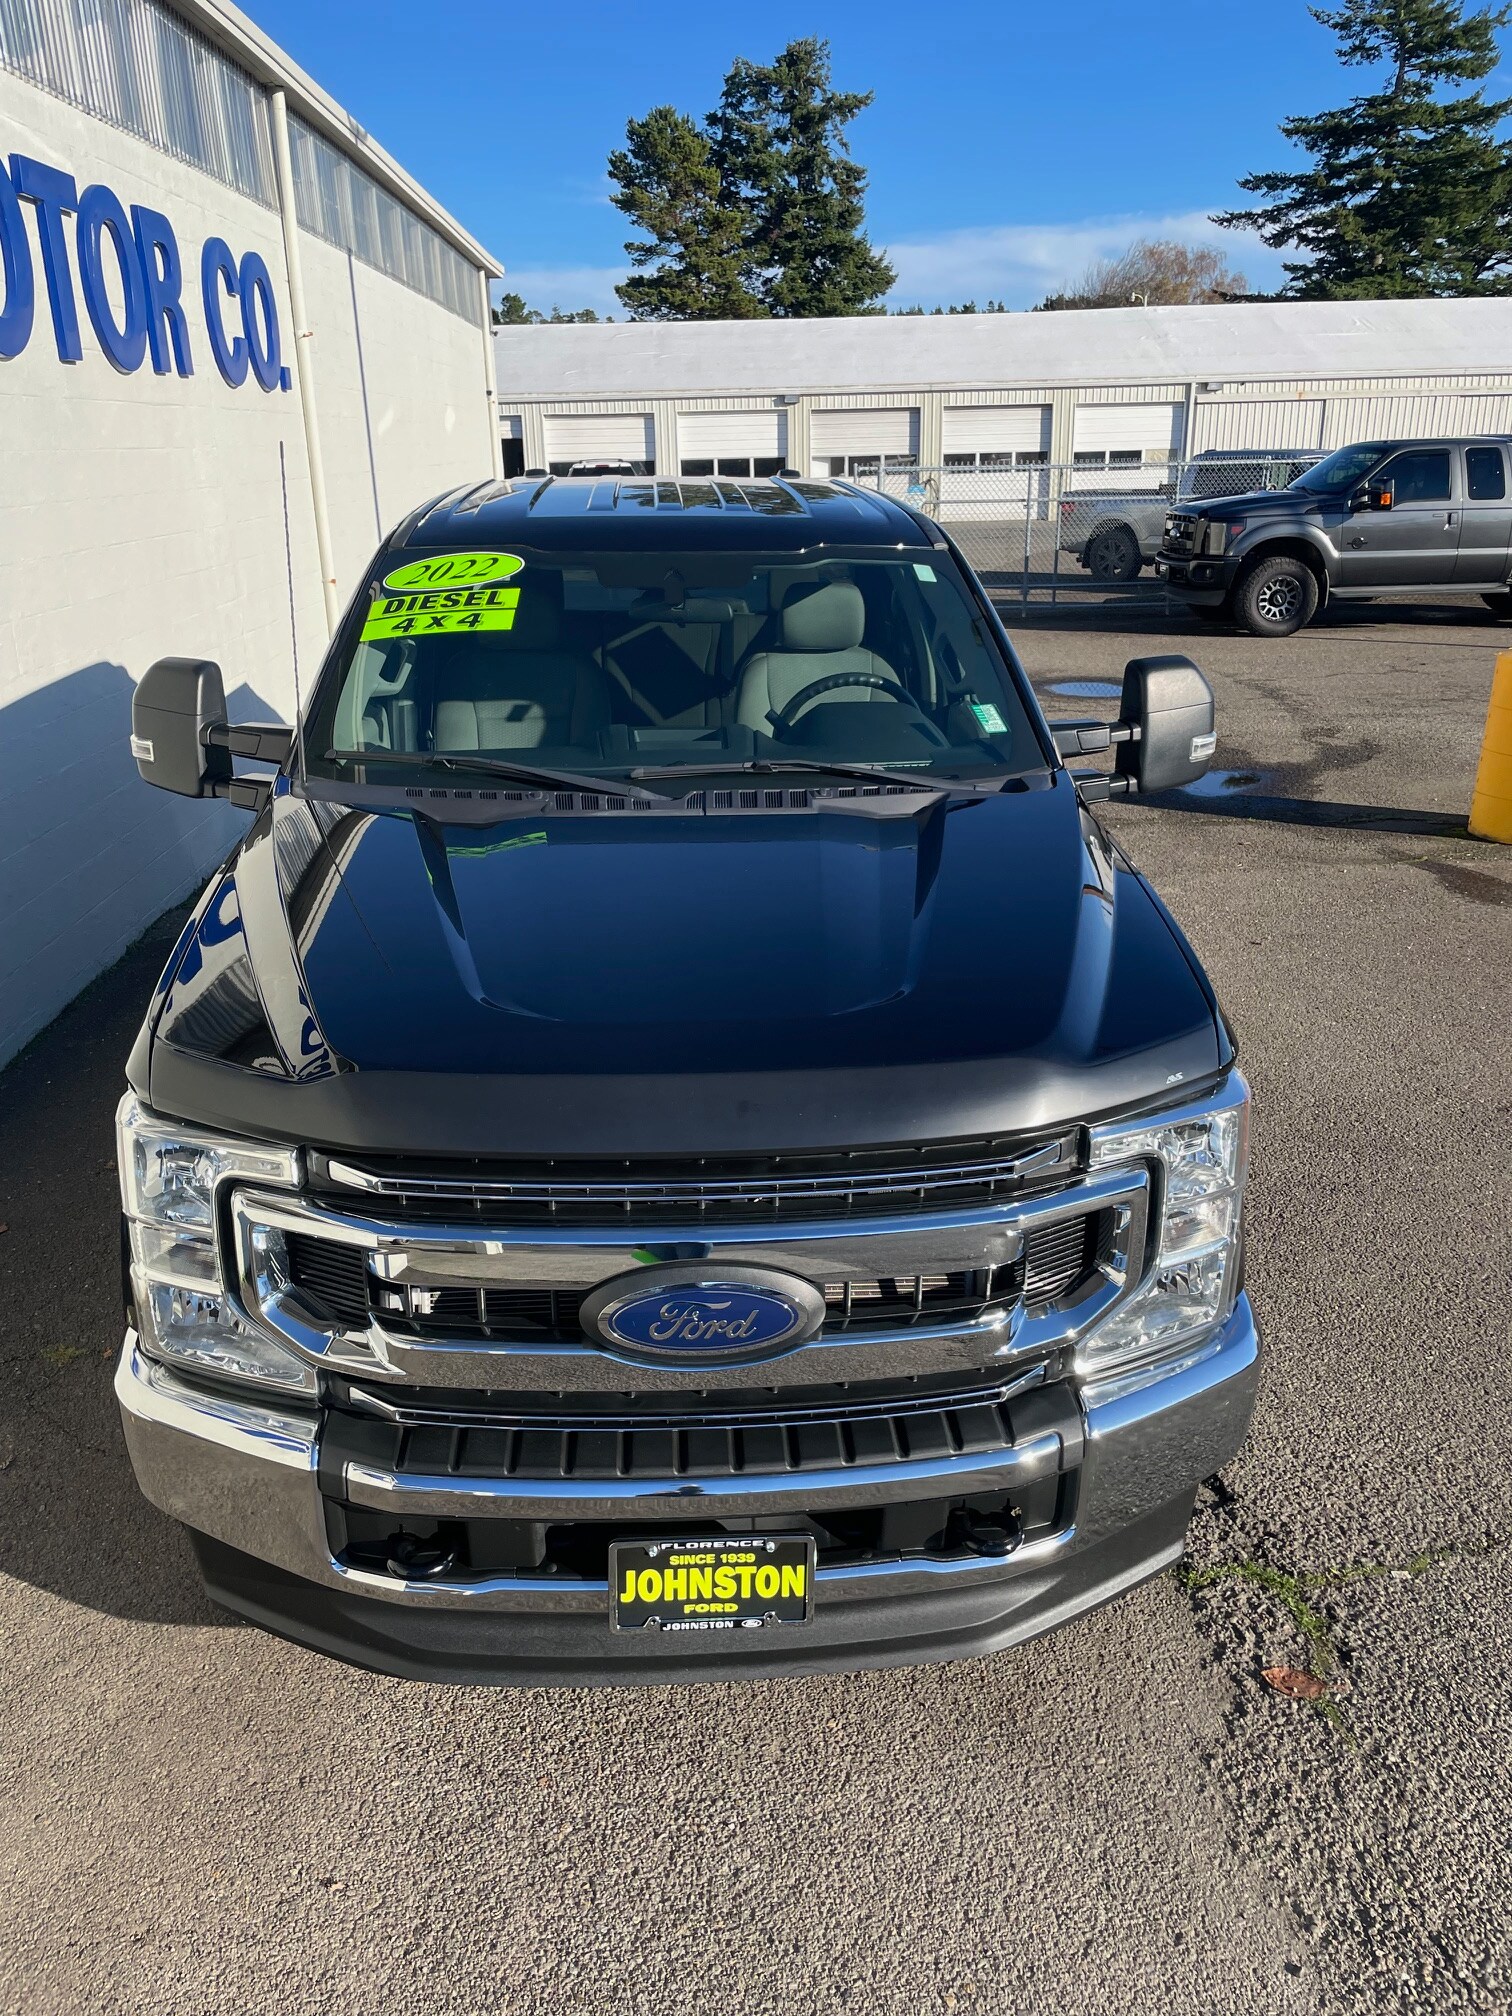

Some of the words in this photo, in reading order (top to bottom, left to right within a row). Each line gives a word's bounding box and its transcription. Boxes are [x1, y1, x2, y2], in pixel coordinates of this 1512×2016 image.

[201, 237, 292, 393] CO.
[403, 557, 500, 586] 2022
[382, 591, 505, 616] DIESEL
[649, 1300, 760, 1341] Ford
[660, 1540, 766, 1550] FLORENCE
[669, 1554, 716, 1566] SINCE
[720, 1553, 756, 1564] 1939
[620, 1565, 805, 1603] JOHNSTON
[683, 1603, 739, 1614] FORD
[662, 1620, 734, 1631] JOHNSTON
